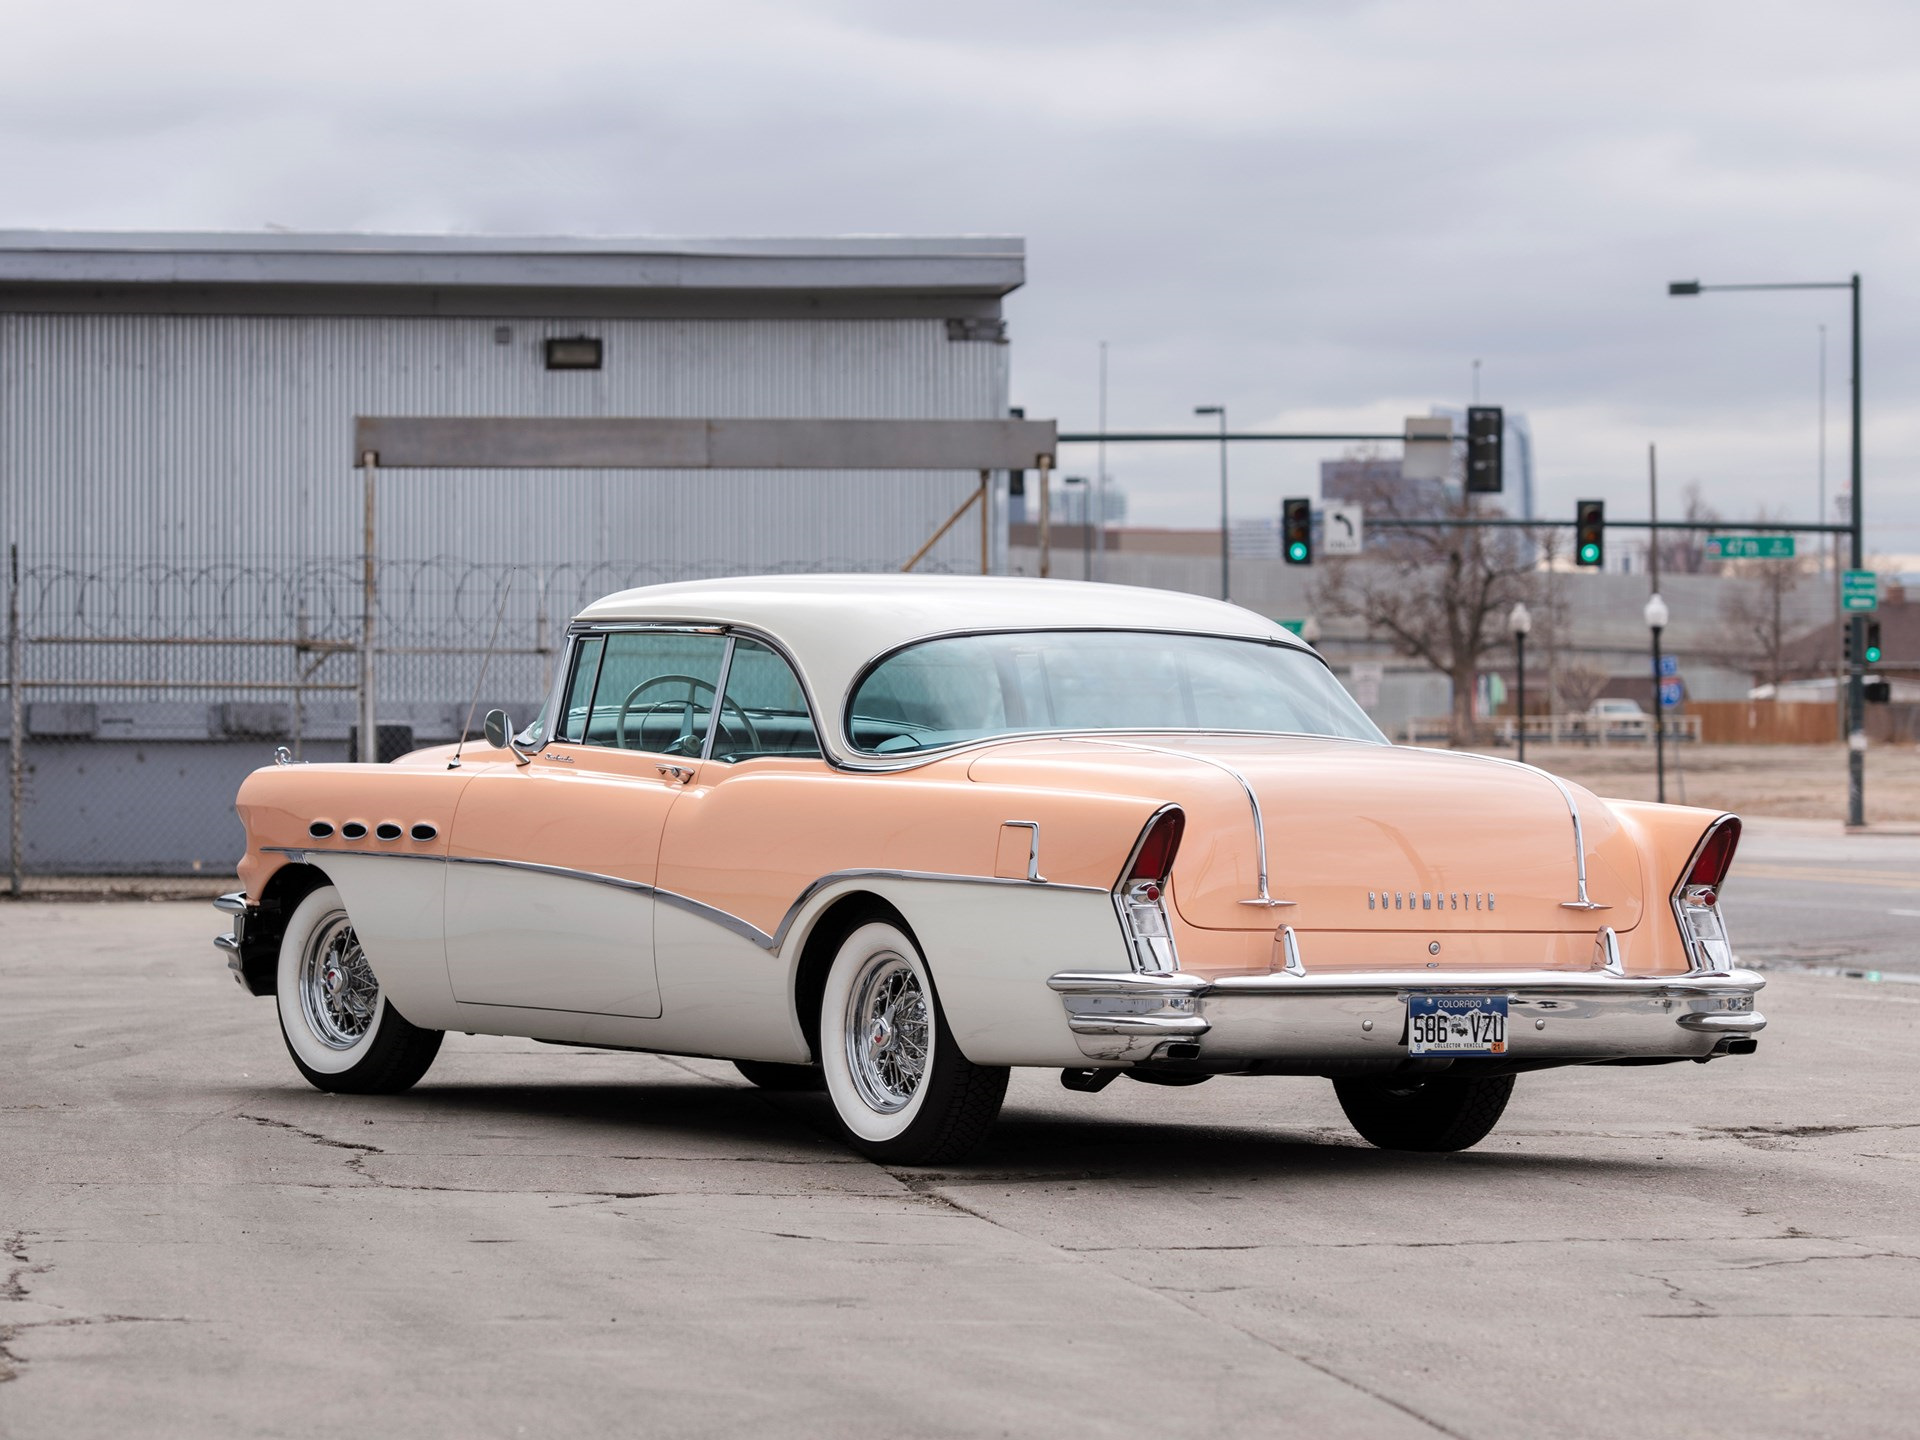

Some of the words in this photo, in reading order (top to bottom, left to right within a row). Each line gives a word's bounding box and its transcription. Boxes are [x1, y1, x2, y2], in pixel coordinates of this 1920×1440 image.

[1368, 891, 1495, 910] ROADMASTER
[1437, 1000, 1482, 1009] COLORADO
[1413, 1016, 1448, 1043] 586
[1470, 1015, 1504, 1043] VZU
[1492, 1043, 1501, 1051] 21
